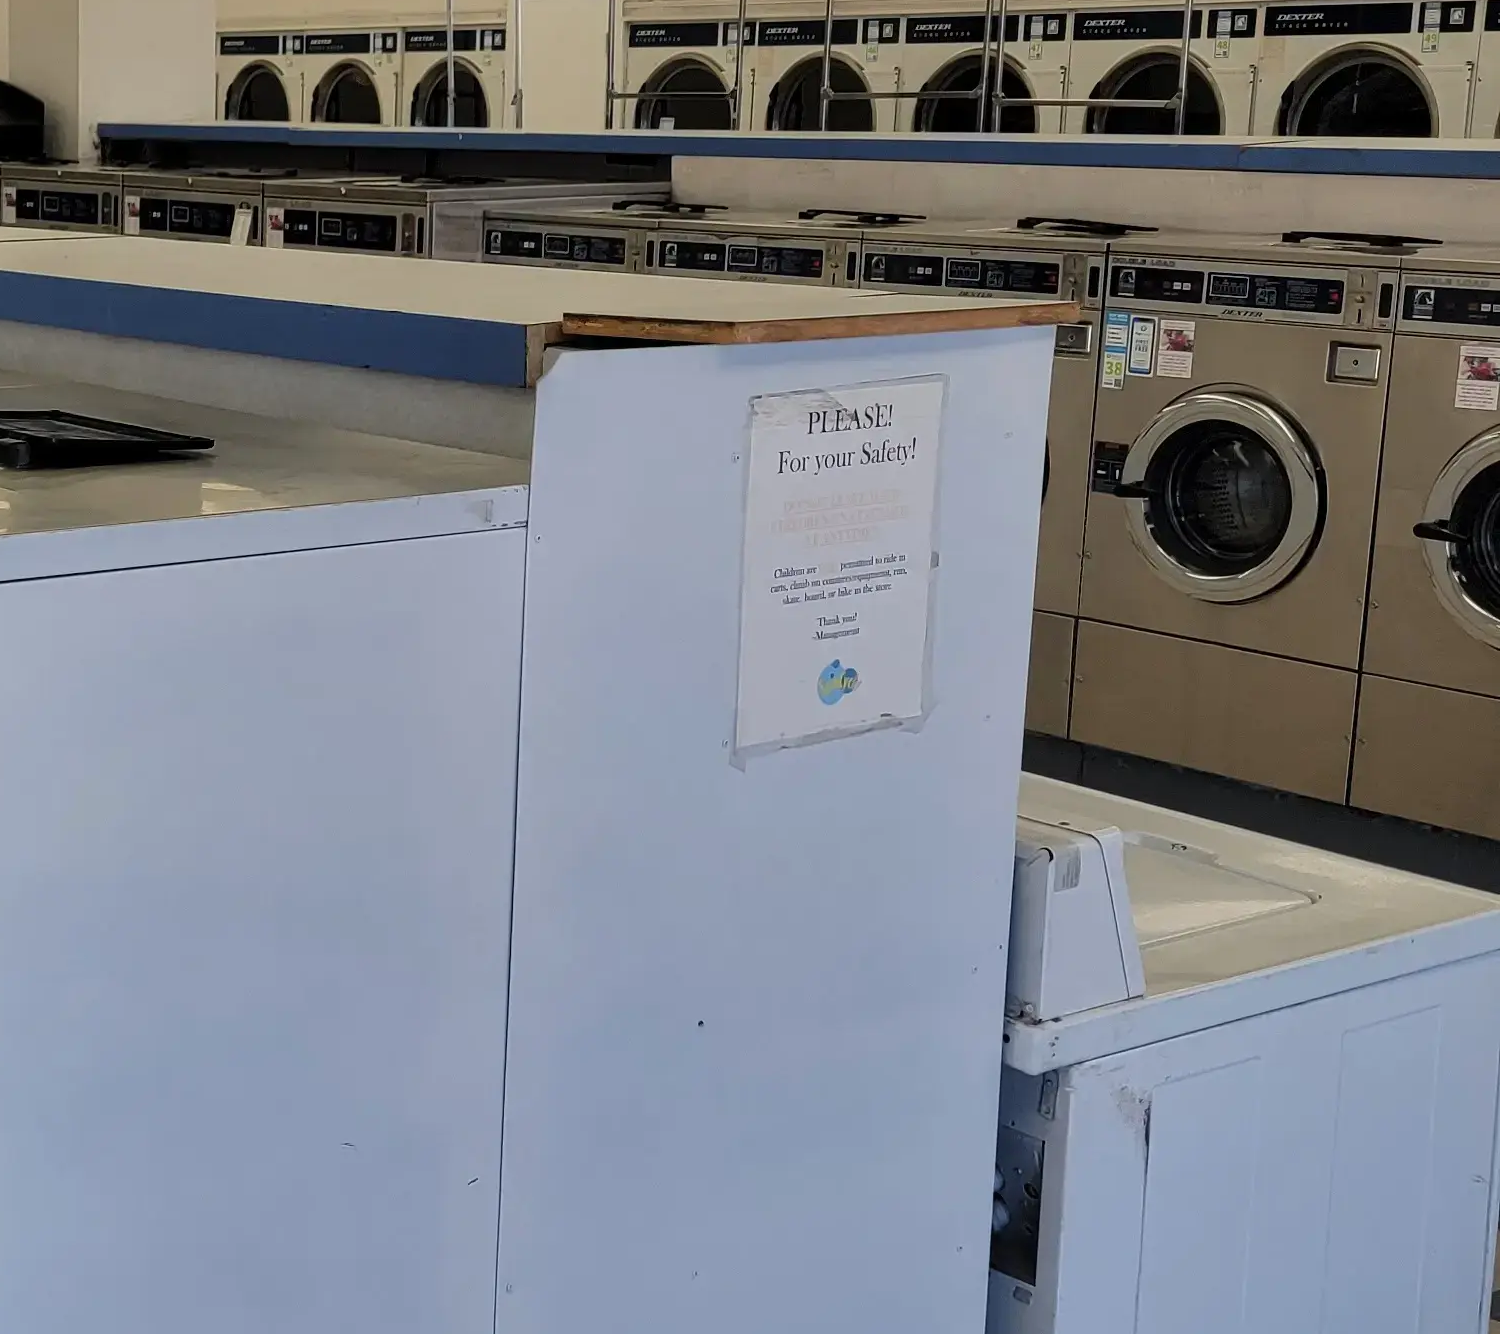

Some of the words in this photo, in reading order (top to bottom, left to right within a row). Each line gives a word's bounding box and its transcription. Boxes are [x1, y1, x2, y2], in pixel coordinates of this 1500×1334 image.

[1084, 19, 1126, 27] DEXTER
[1276, 13, 1324, 21] DEXTER
[1424, 33, 1437, 43] 49
[1221, 308, 1264, 319] DEXTER
[1105, 362, 1122, 376] 38
[807, 403, 893, 435] PLEASE!
[777, 450, 810, 474] For
[814, 450, 855, 475] your
[860, 437, 917, 466] Safety!
[816, 614, 840, 627] Thank
